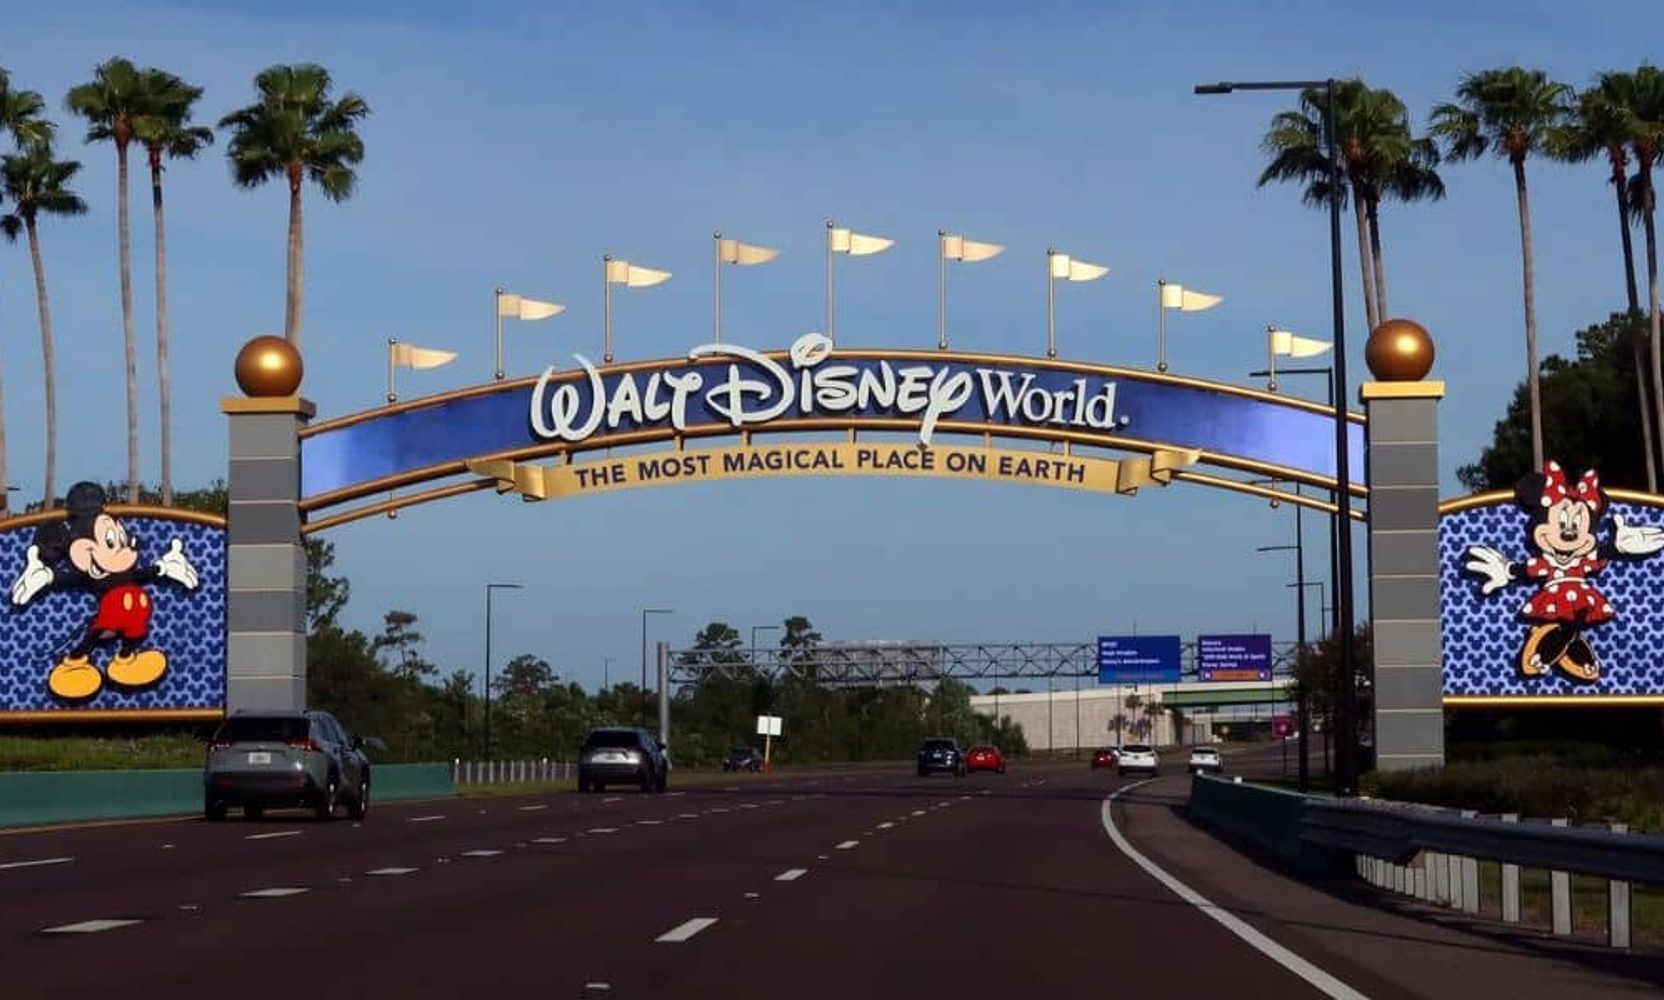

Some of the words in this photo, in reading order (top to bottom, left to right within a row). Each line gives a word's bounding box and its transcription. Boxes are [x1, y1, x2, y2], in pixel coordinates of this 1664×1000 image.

[575, 464, 626, 489] THE
[639, 455, 711, 481] MOST
[723, 450, 843, 473] MAGICAL
[857, 450, 934, 470] PLACE
[946, 453, 986, 473] ON
[999, 457, 1085, 483] EARTH
